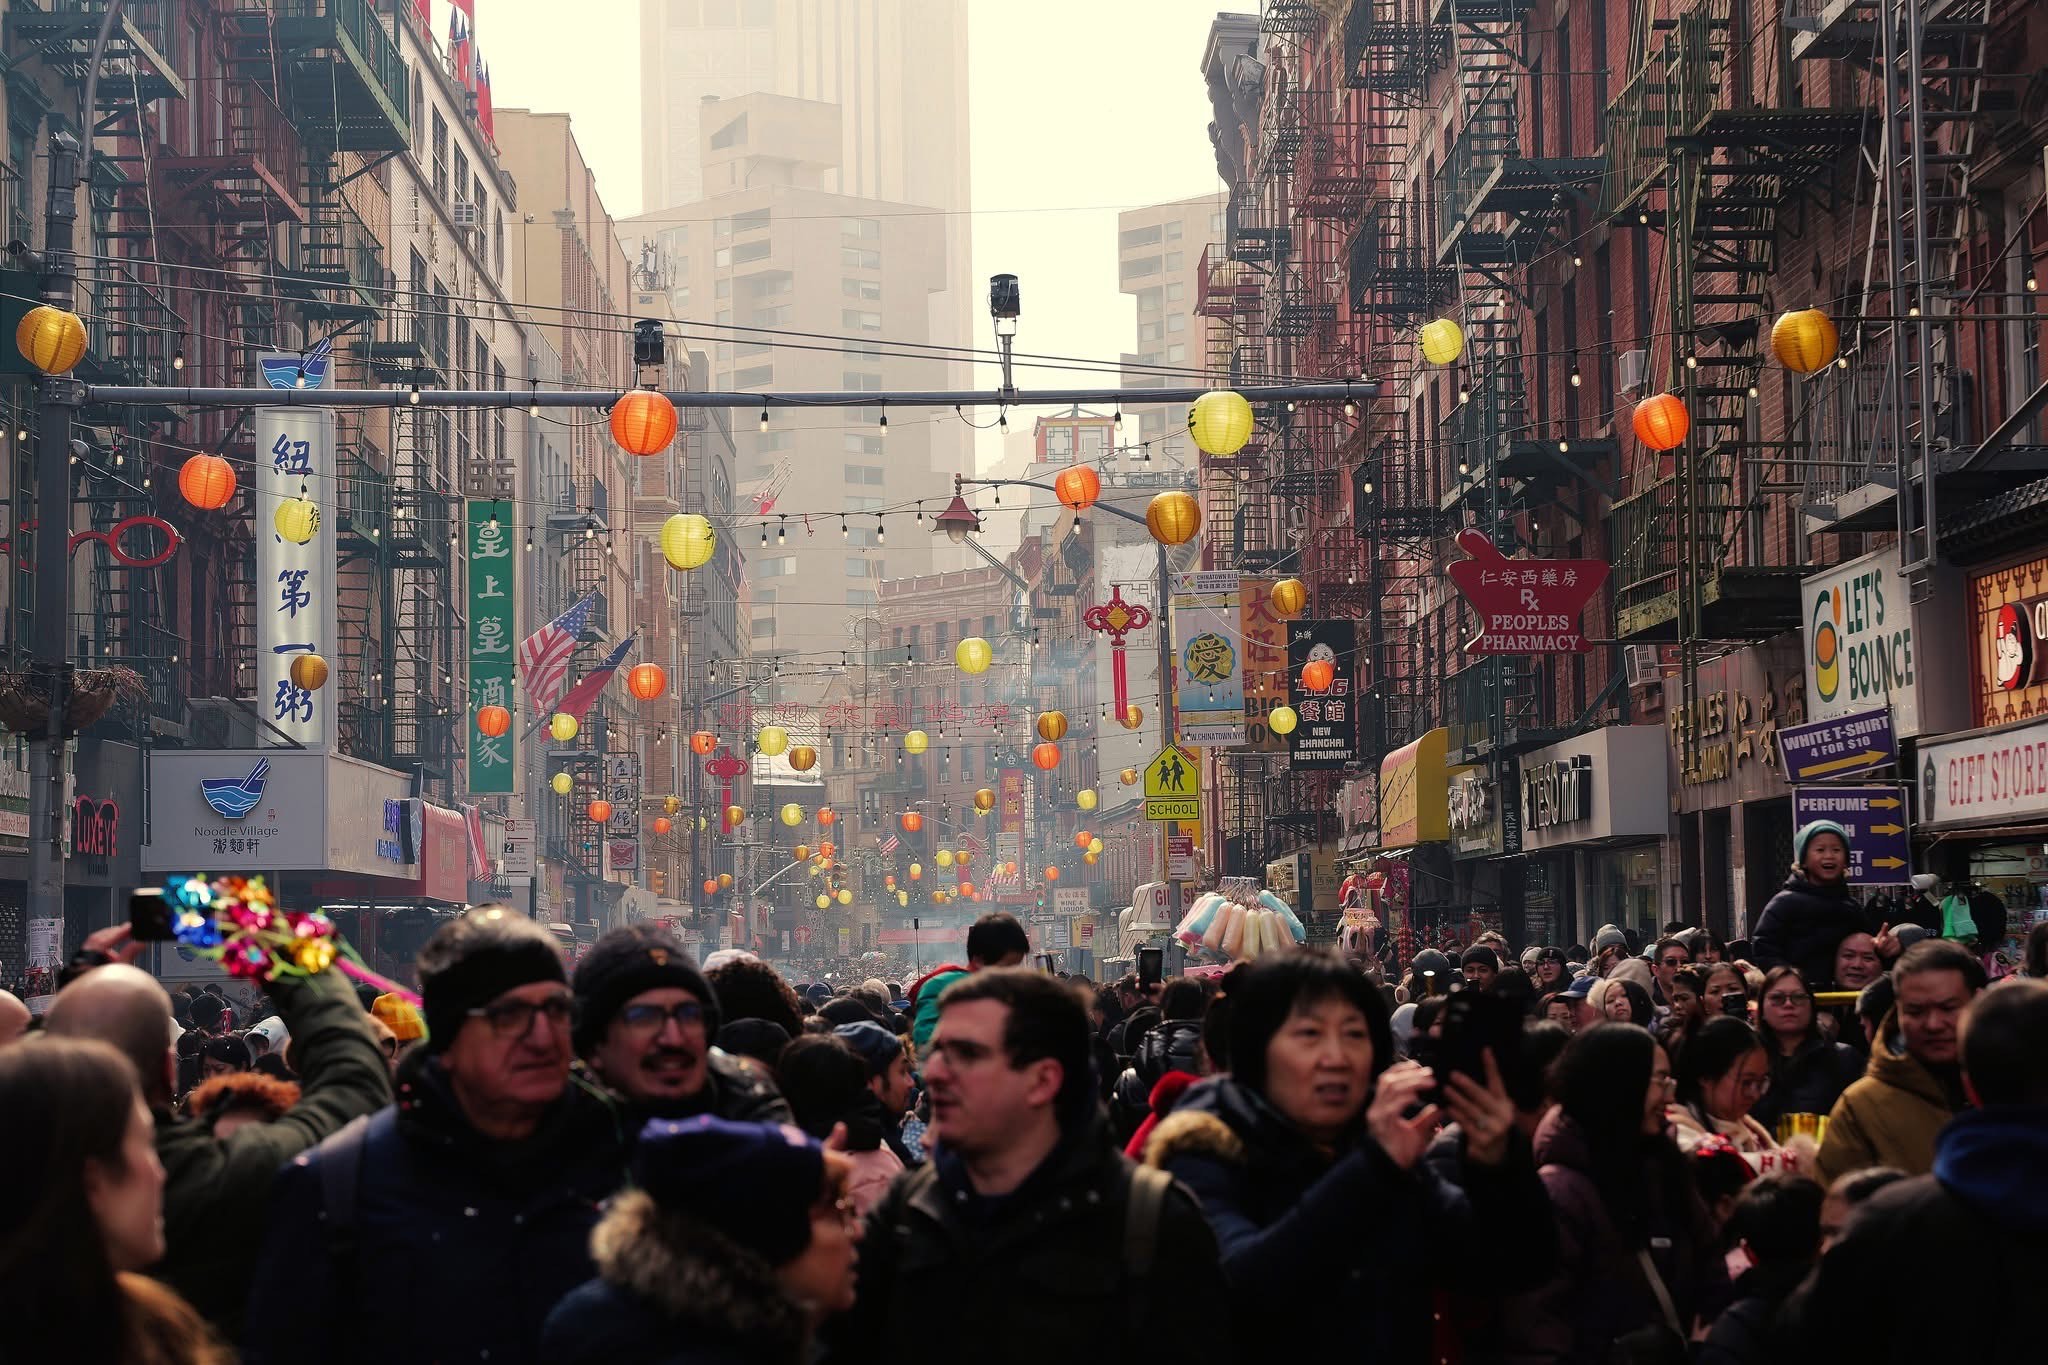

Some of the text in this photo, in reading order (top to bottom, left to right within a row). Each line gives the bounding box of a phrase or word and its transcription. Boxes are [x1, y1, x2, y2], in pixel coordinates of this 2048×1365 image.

[271, 433, 314, 723] 紐第一粥
[1479, 568, 1579, 588] 仁安西藥房
[1845, 568, 1885, 636] LET'S
[1491, 614, 1570, 631] PEOPLES
[1482, 634, 1580, 651] PHARMACY
[1186, 633, 1230, 681] 愛
[1849, 627, 1914, 702] BOUNCE
[1244, 697, 1283, 717] BIG
[1299, 700, 1347, 722] 餐館
[1312, 727, 1332, 737] NEW
[1784, 715, 1890, 751] WHITE T-SHIRT
[1299, 738, 1345, 749] SHANGHAI
[1810, 736, 1871, 758] 4 FOR $10
[1293, 750, 1353, 761] RESTAURANT
[1948, 755, 1986, 806] GIFT
[1149, 804, 1197, 815] SCHOOL
[1799, 797, 1869, 812] PERFUME
[194, 826, 279, 838] Noodle Village
[213, 838, 260, 858] 粥麵軒
